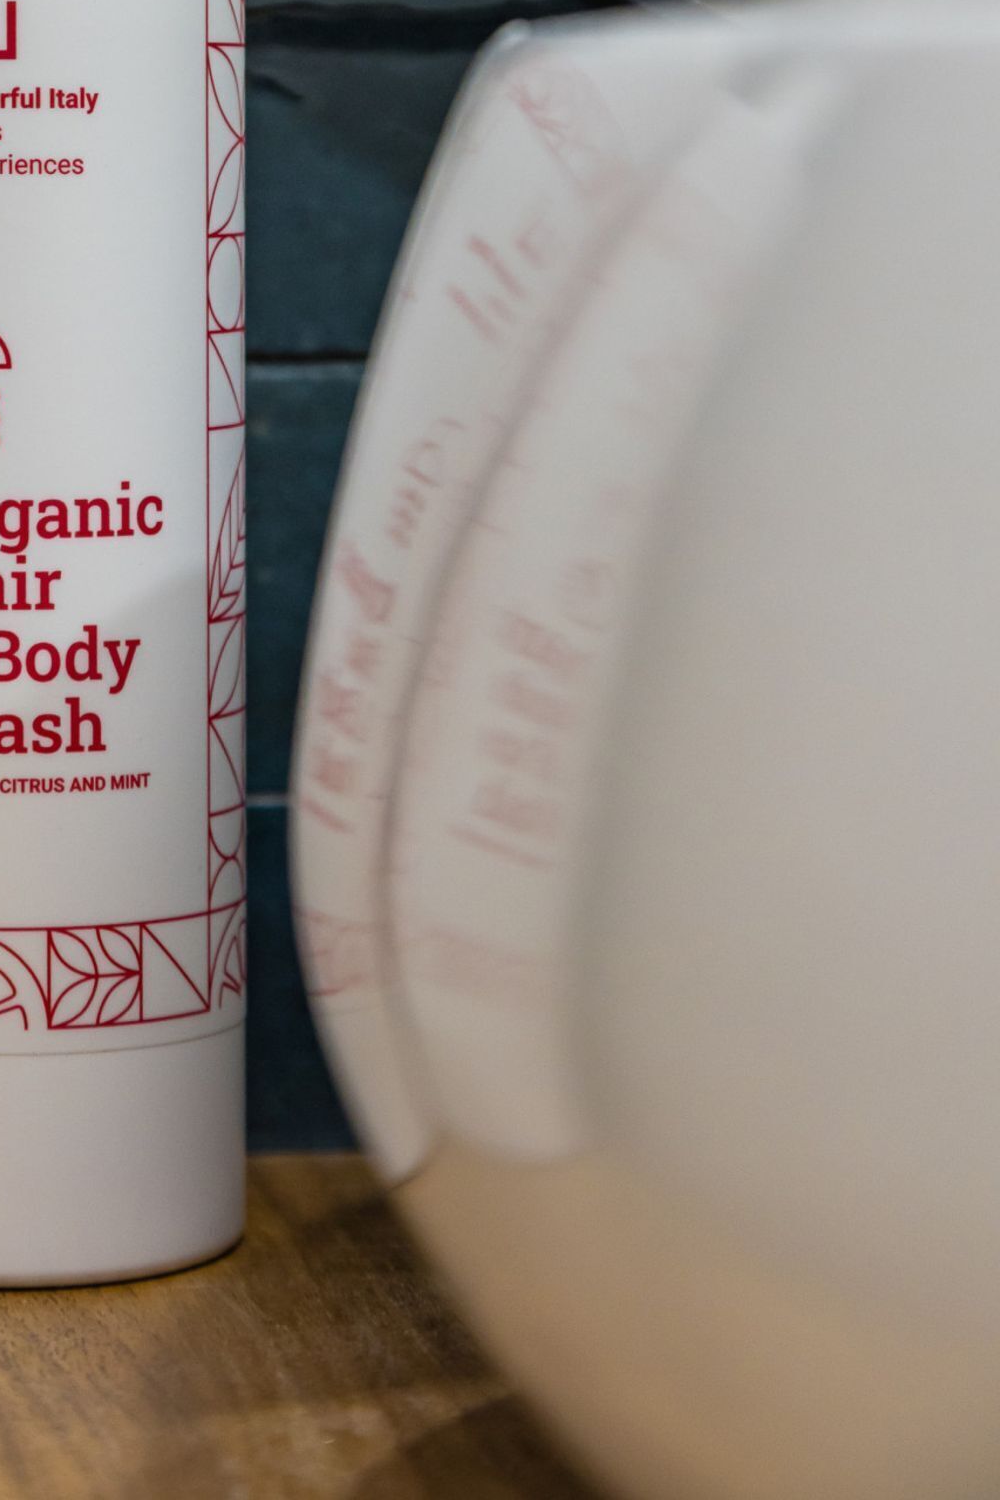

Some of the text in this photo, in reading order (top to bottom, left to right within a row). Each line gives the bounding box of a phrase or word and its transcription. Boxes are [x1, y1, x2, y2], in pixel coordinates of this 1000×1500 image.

[49, 87, 99, 114] Italy
[0, 777, 65, 794] CITRUS
[69, 775, 106, 793] AND
[110, 772, 150, 790] MINT
